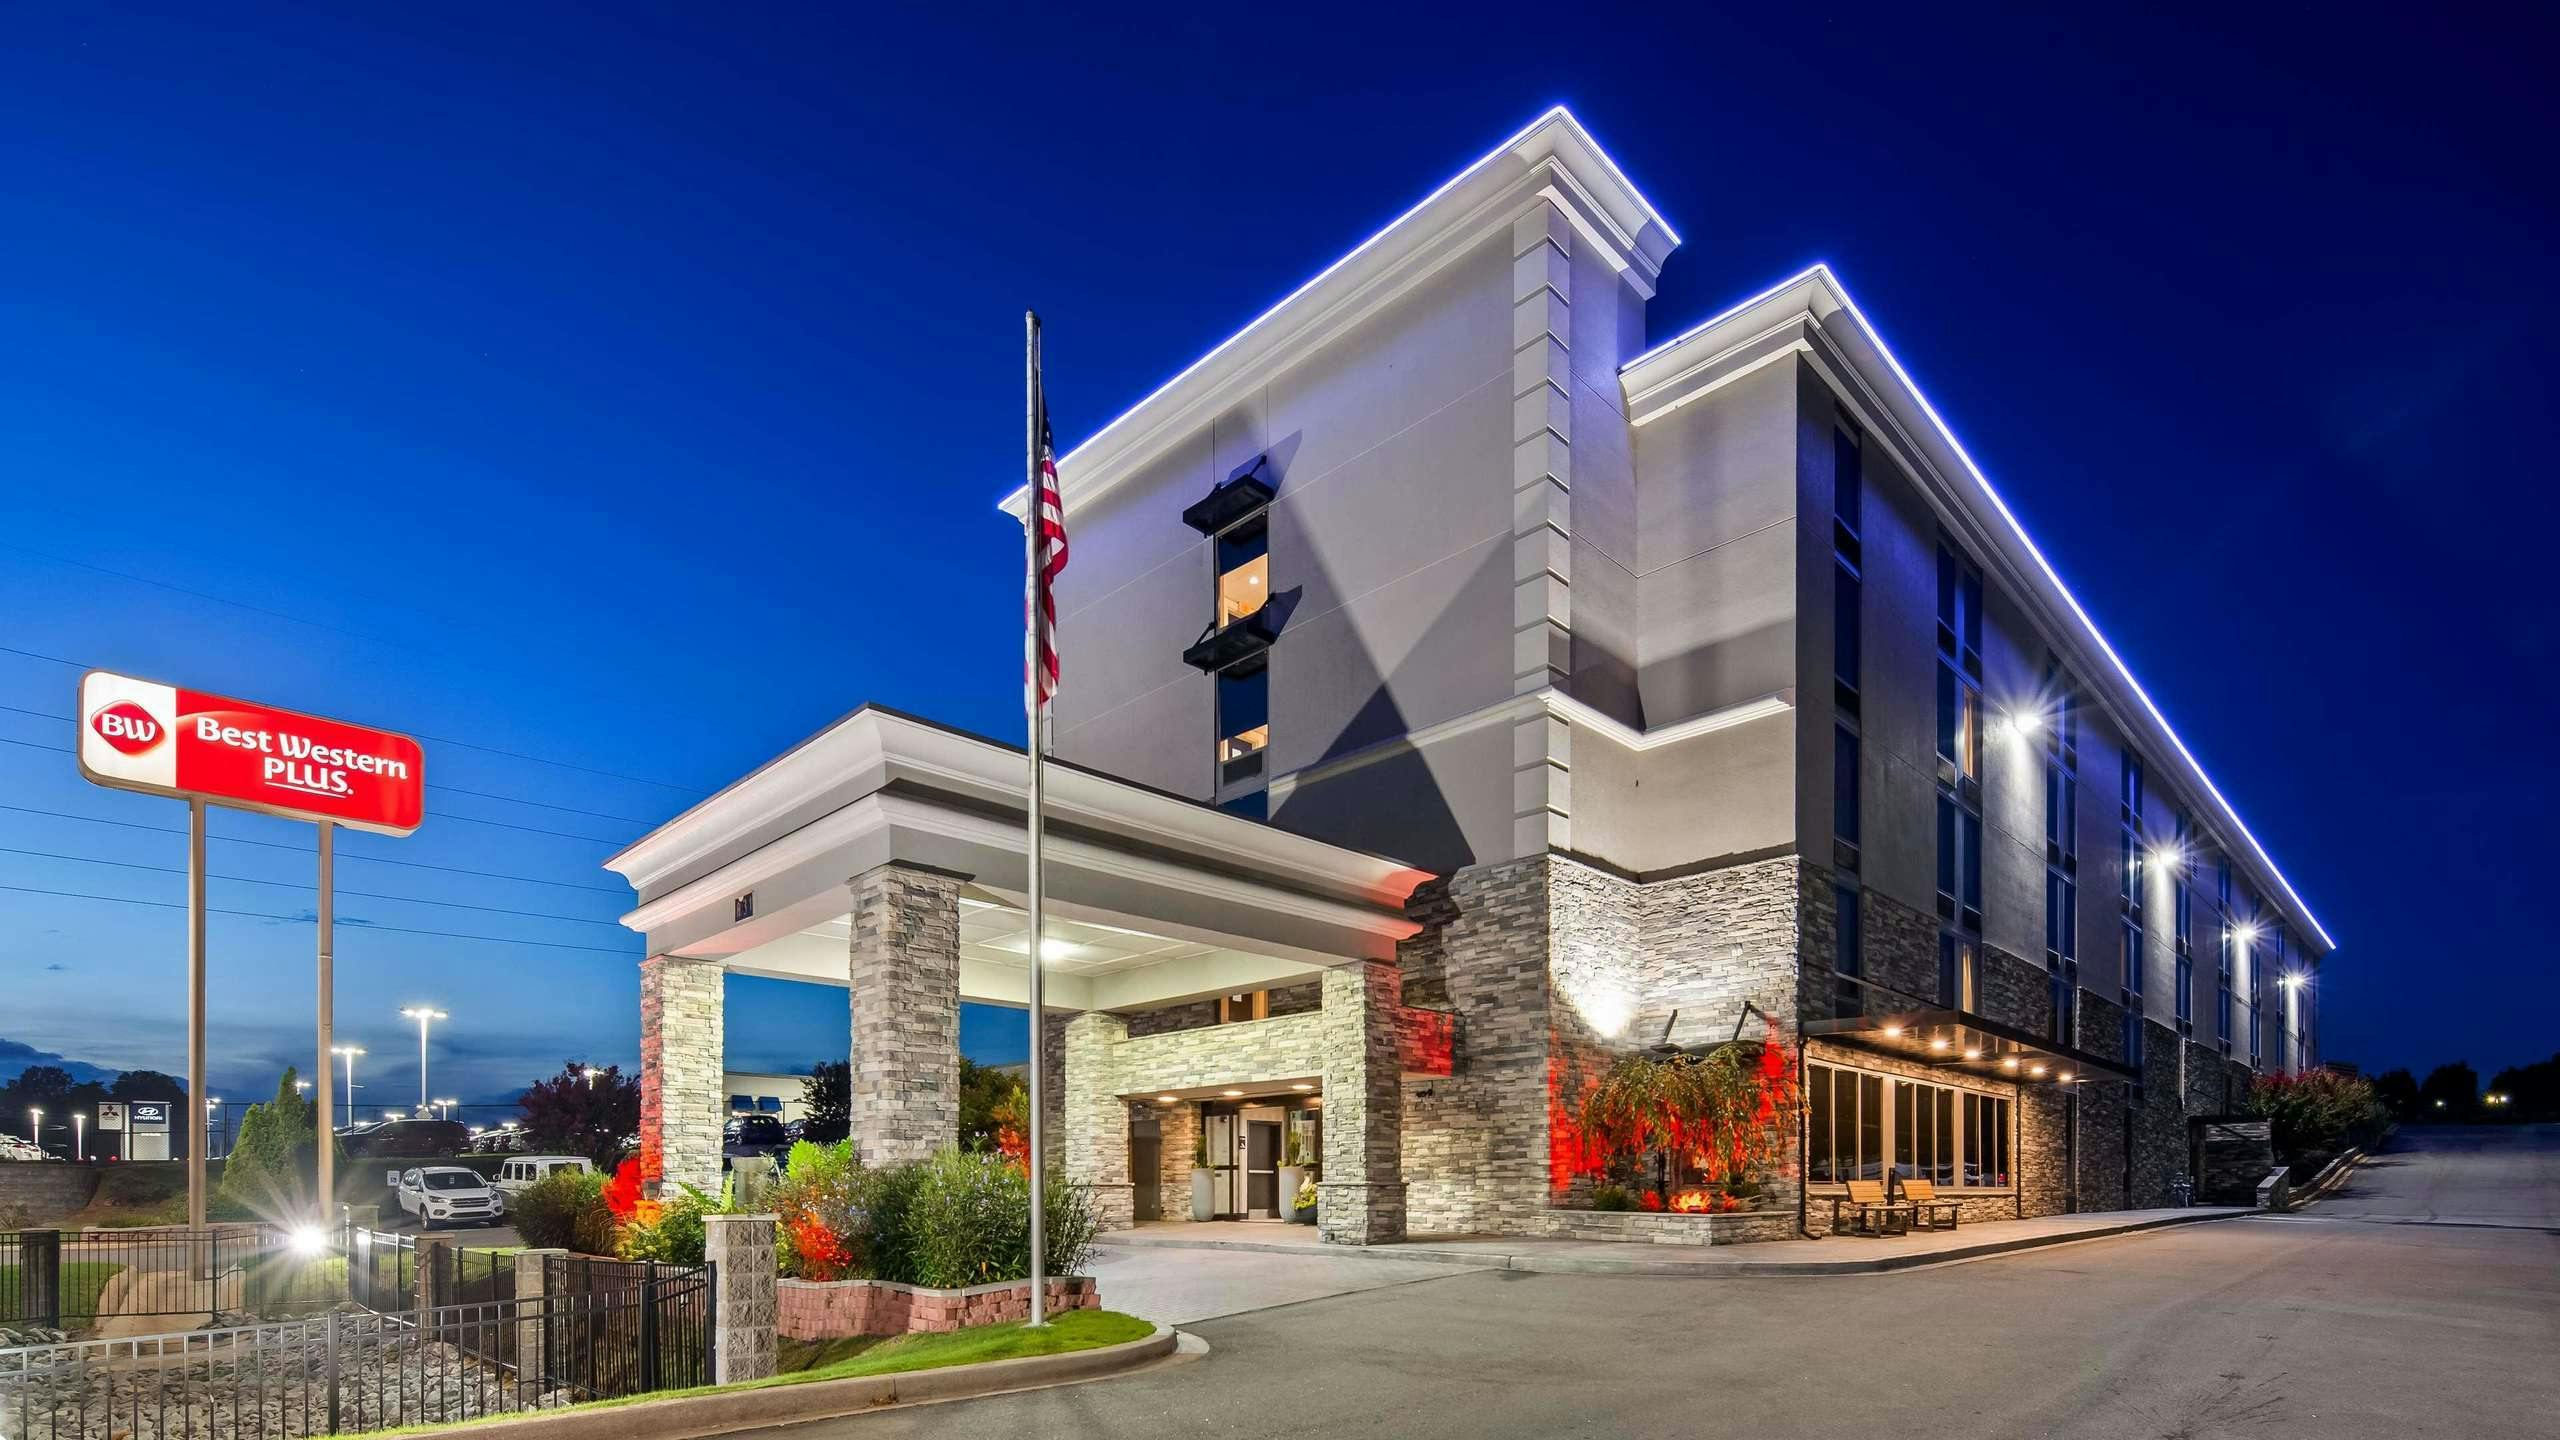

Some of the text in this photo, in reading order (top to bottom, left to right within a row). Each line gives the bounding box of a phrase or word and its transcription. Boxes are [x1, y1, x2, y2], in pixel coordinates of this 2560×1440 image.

[102, 713, 156, 742] BW
[197, 716, 408, 780] Best Western
